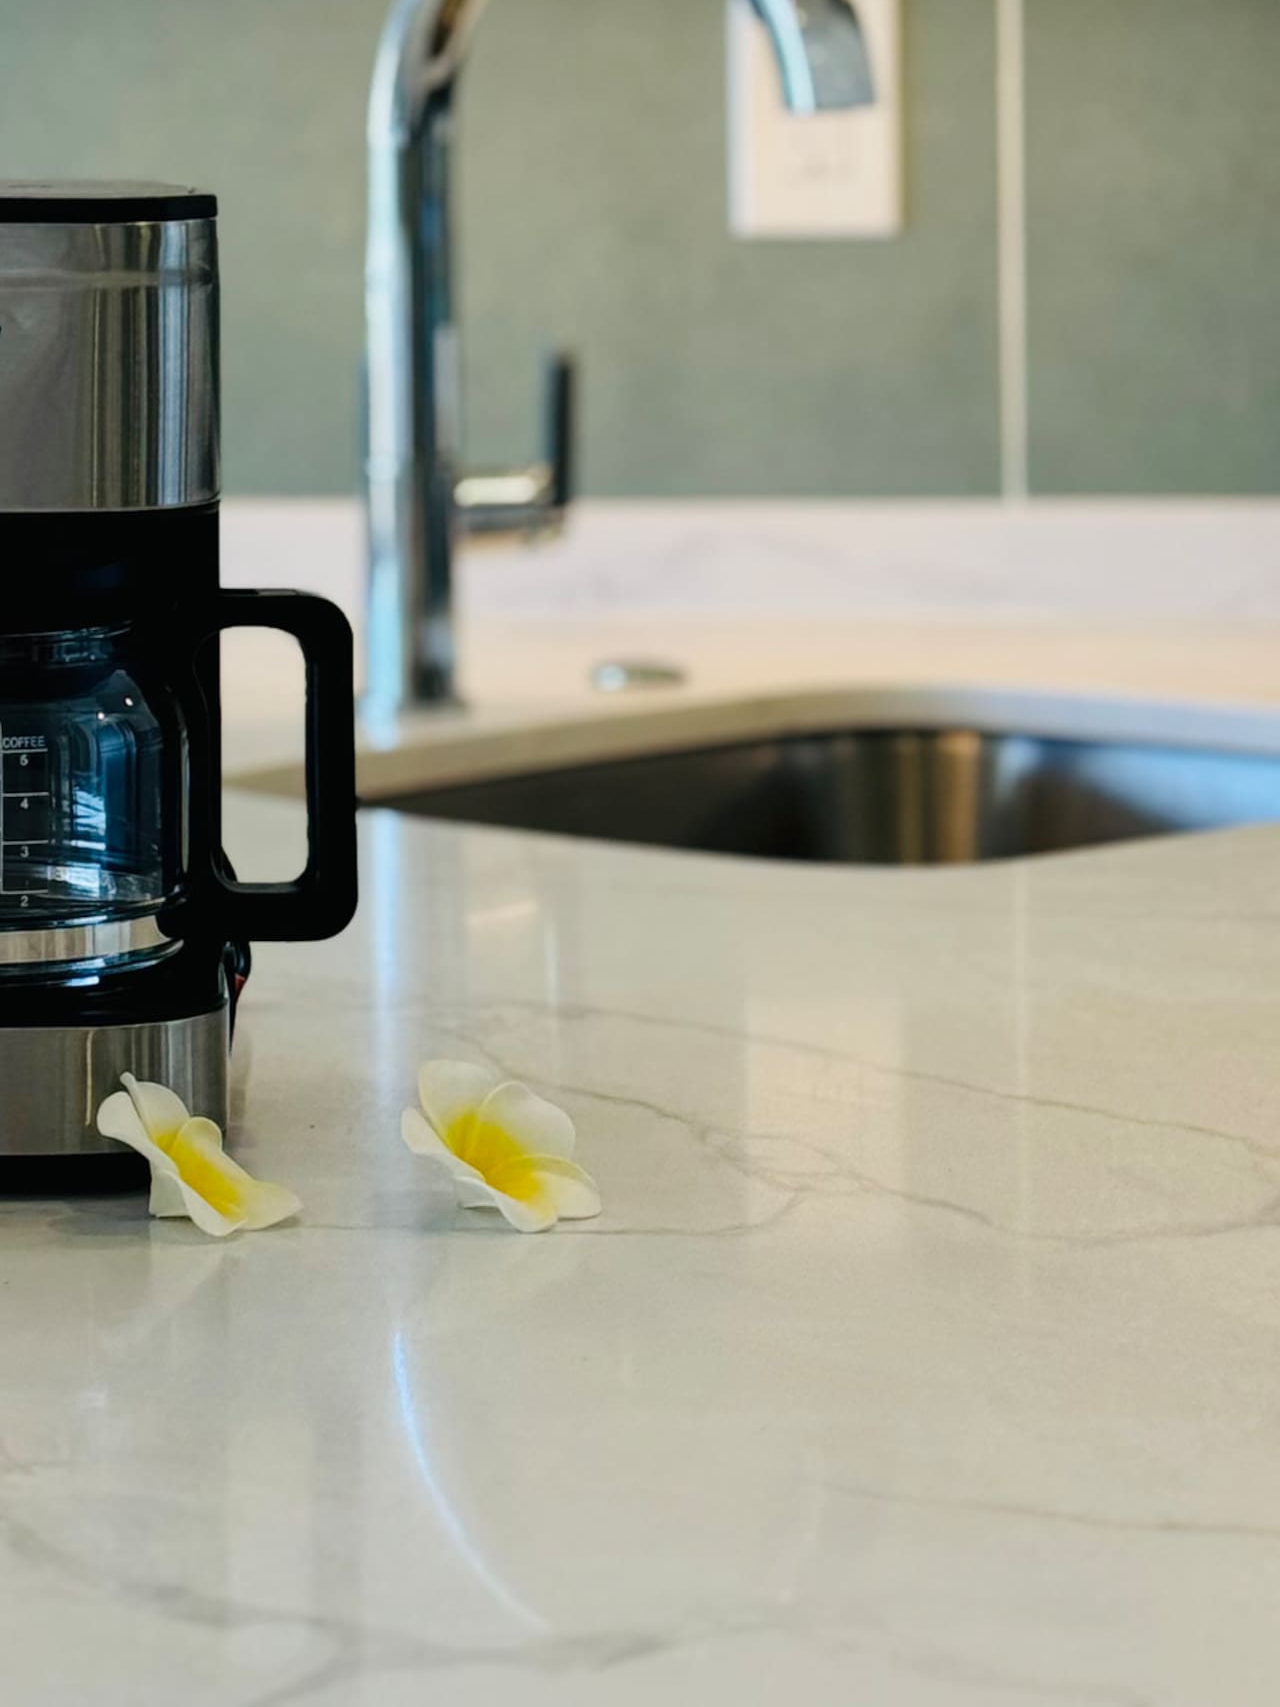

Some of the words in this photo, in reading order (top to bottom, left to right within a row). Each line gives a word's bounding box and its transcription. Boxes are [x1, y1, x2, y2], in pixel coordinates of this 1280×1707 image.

[2, 736, 46, 748] COFFEE
[20, 799, 29, 810] 4
[20, 846, 29, 858] 3
[20, 896, 29, 907] 2
